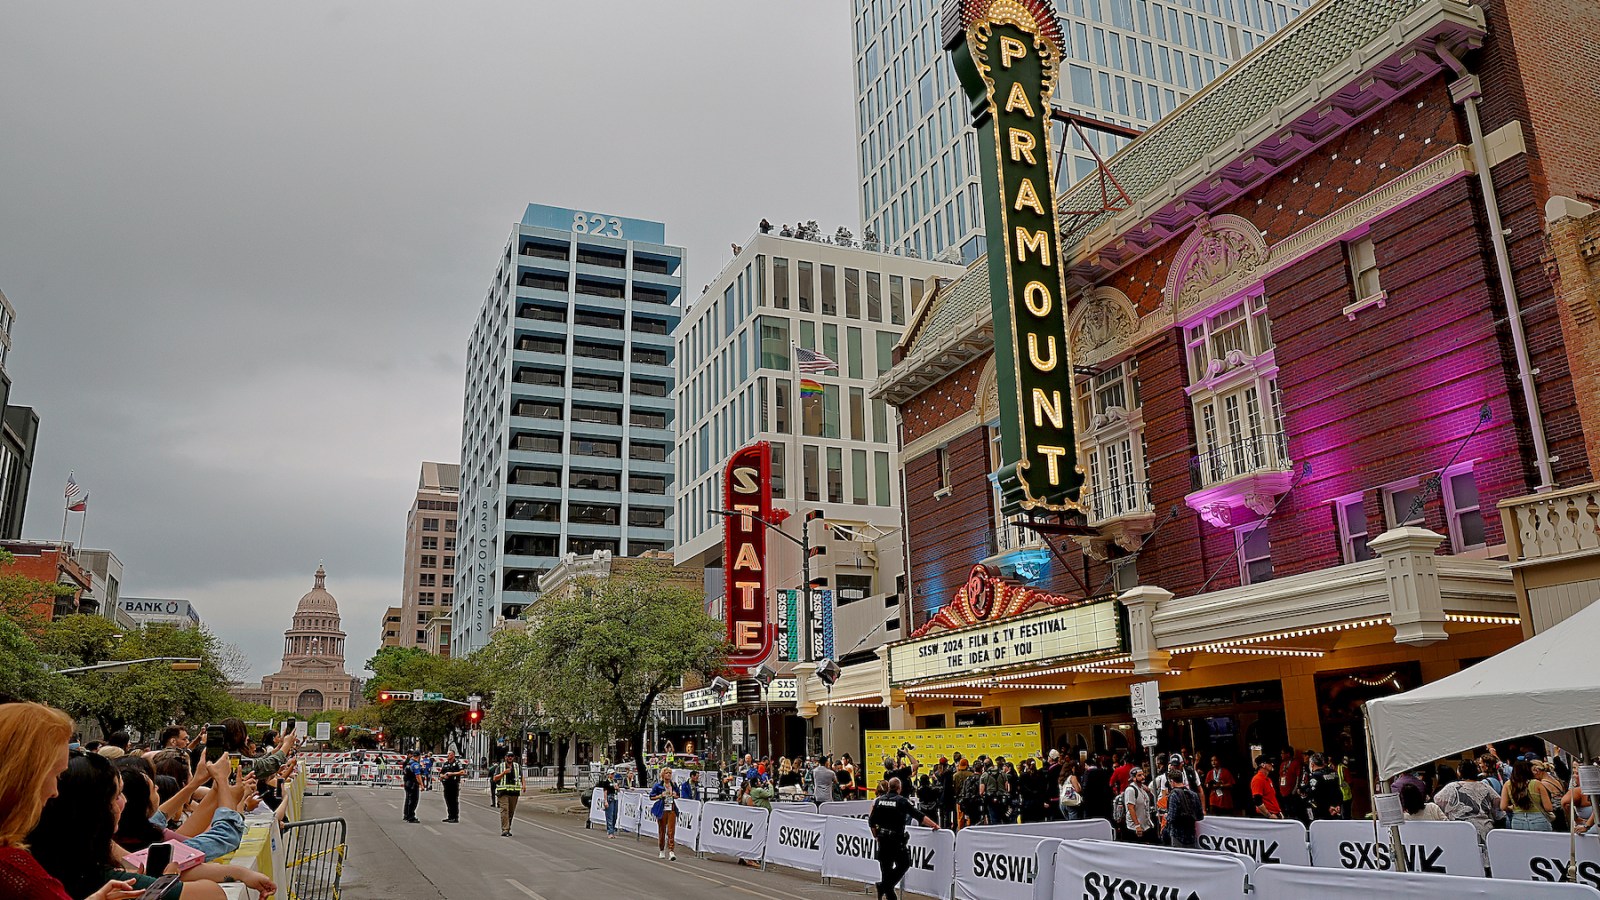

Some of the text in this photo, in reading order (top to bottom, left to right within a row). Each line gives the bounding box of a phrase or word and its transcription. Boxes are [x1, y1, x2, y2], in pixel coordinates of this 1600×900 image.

[572, 211, 623, 239] 823
[999, 34, 1066, 486] PARAMOUNT
[733, 467, 762, 650] STATE
[477, 538, 488, 632] CONGRESS
[125, 601, 163, 612] BANK
[778, 593, 788, 658] SXSW 2024
[813, 593, 824, 658] SXSW 2024
[918, 617, 1067, 658] SXSW 2024 FILM & TV FESTIVAL
[947, 641, 1032, 668] THE IDEA OF YOU
[713, 817, 743, 837] SXSW
[779, 825, 811, 849] SXSW
[836, 833, 873, 859] SXSW
[973, 851, 1025, 883] SXSW
